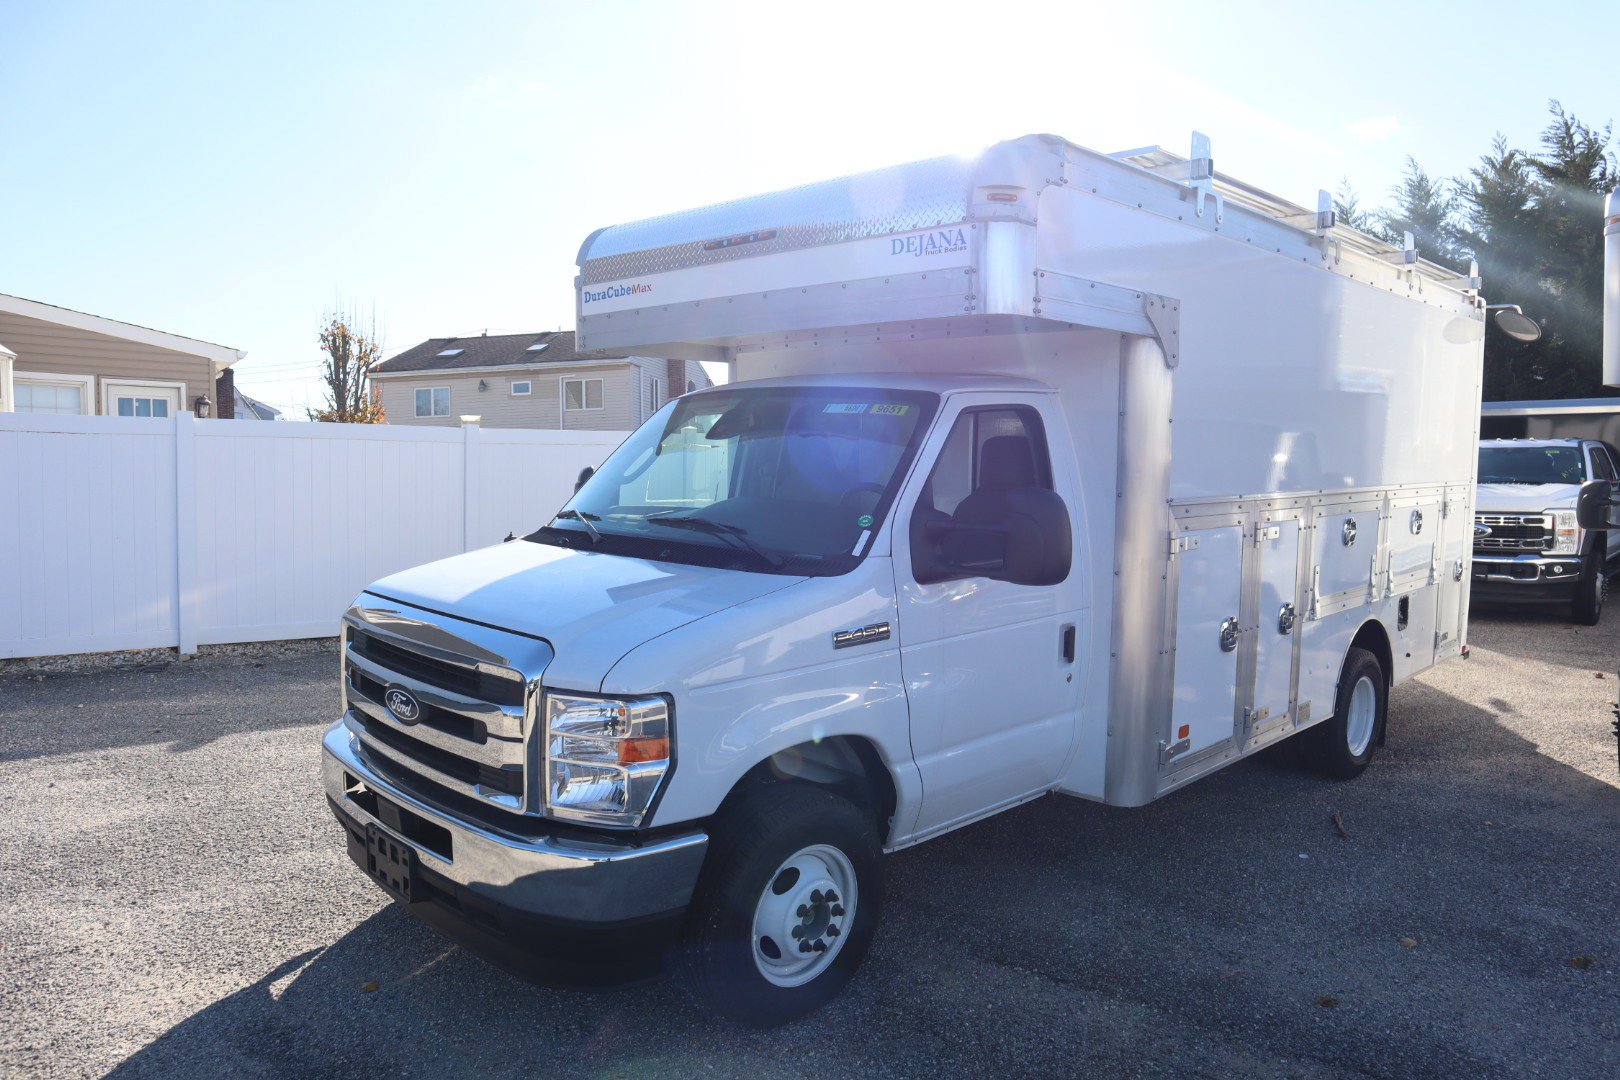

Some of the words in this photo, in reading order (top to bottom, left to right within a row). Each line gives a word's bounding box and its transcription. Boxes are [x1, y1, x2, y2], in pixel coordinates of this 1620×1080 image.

[890, 228, 967, 257] DEJANA
[925, 248, 943, 256] Truck
[944, 245, 967, 254] Bodies
[584, 283, 652, 304] DuraCubeMax
[876, 405, 902, 415] 9651
[390, 692, 412, 717] Ford
